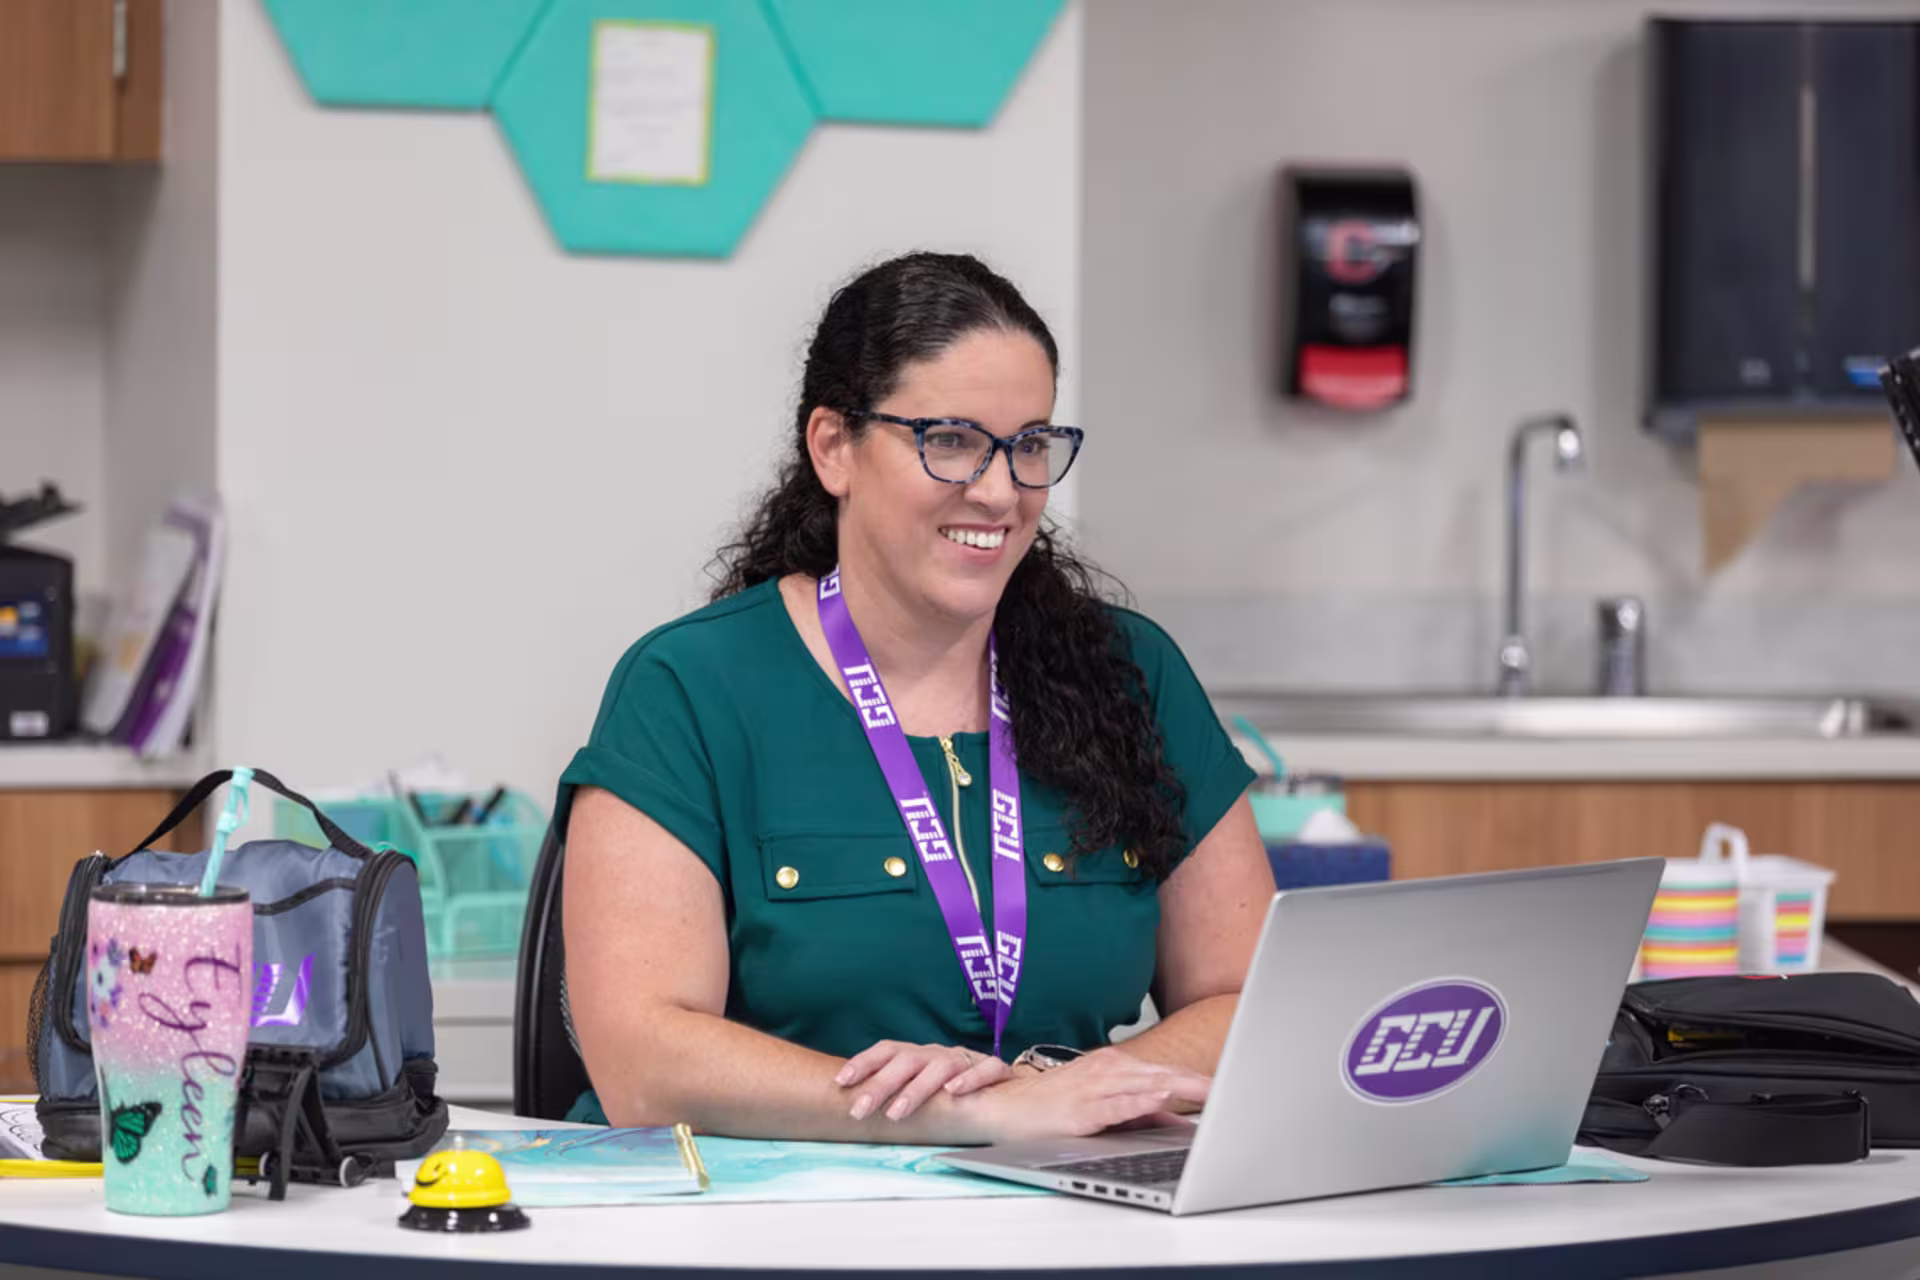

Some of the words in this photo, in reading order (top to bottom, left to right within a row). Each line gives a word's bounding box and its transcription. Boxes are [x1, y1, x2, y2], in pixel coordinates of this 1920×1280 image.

[843, 663, 896, 729] GCU
[899, 797, 954, 863] GCU
[992, 788, 1020, 862] GCU
[955, 934, 998, 1001] GCU
[997, 930, 1022, 1008] GCU
[1354, 1006, 1497, 1077] GCU
